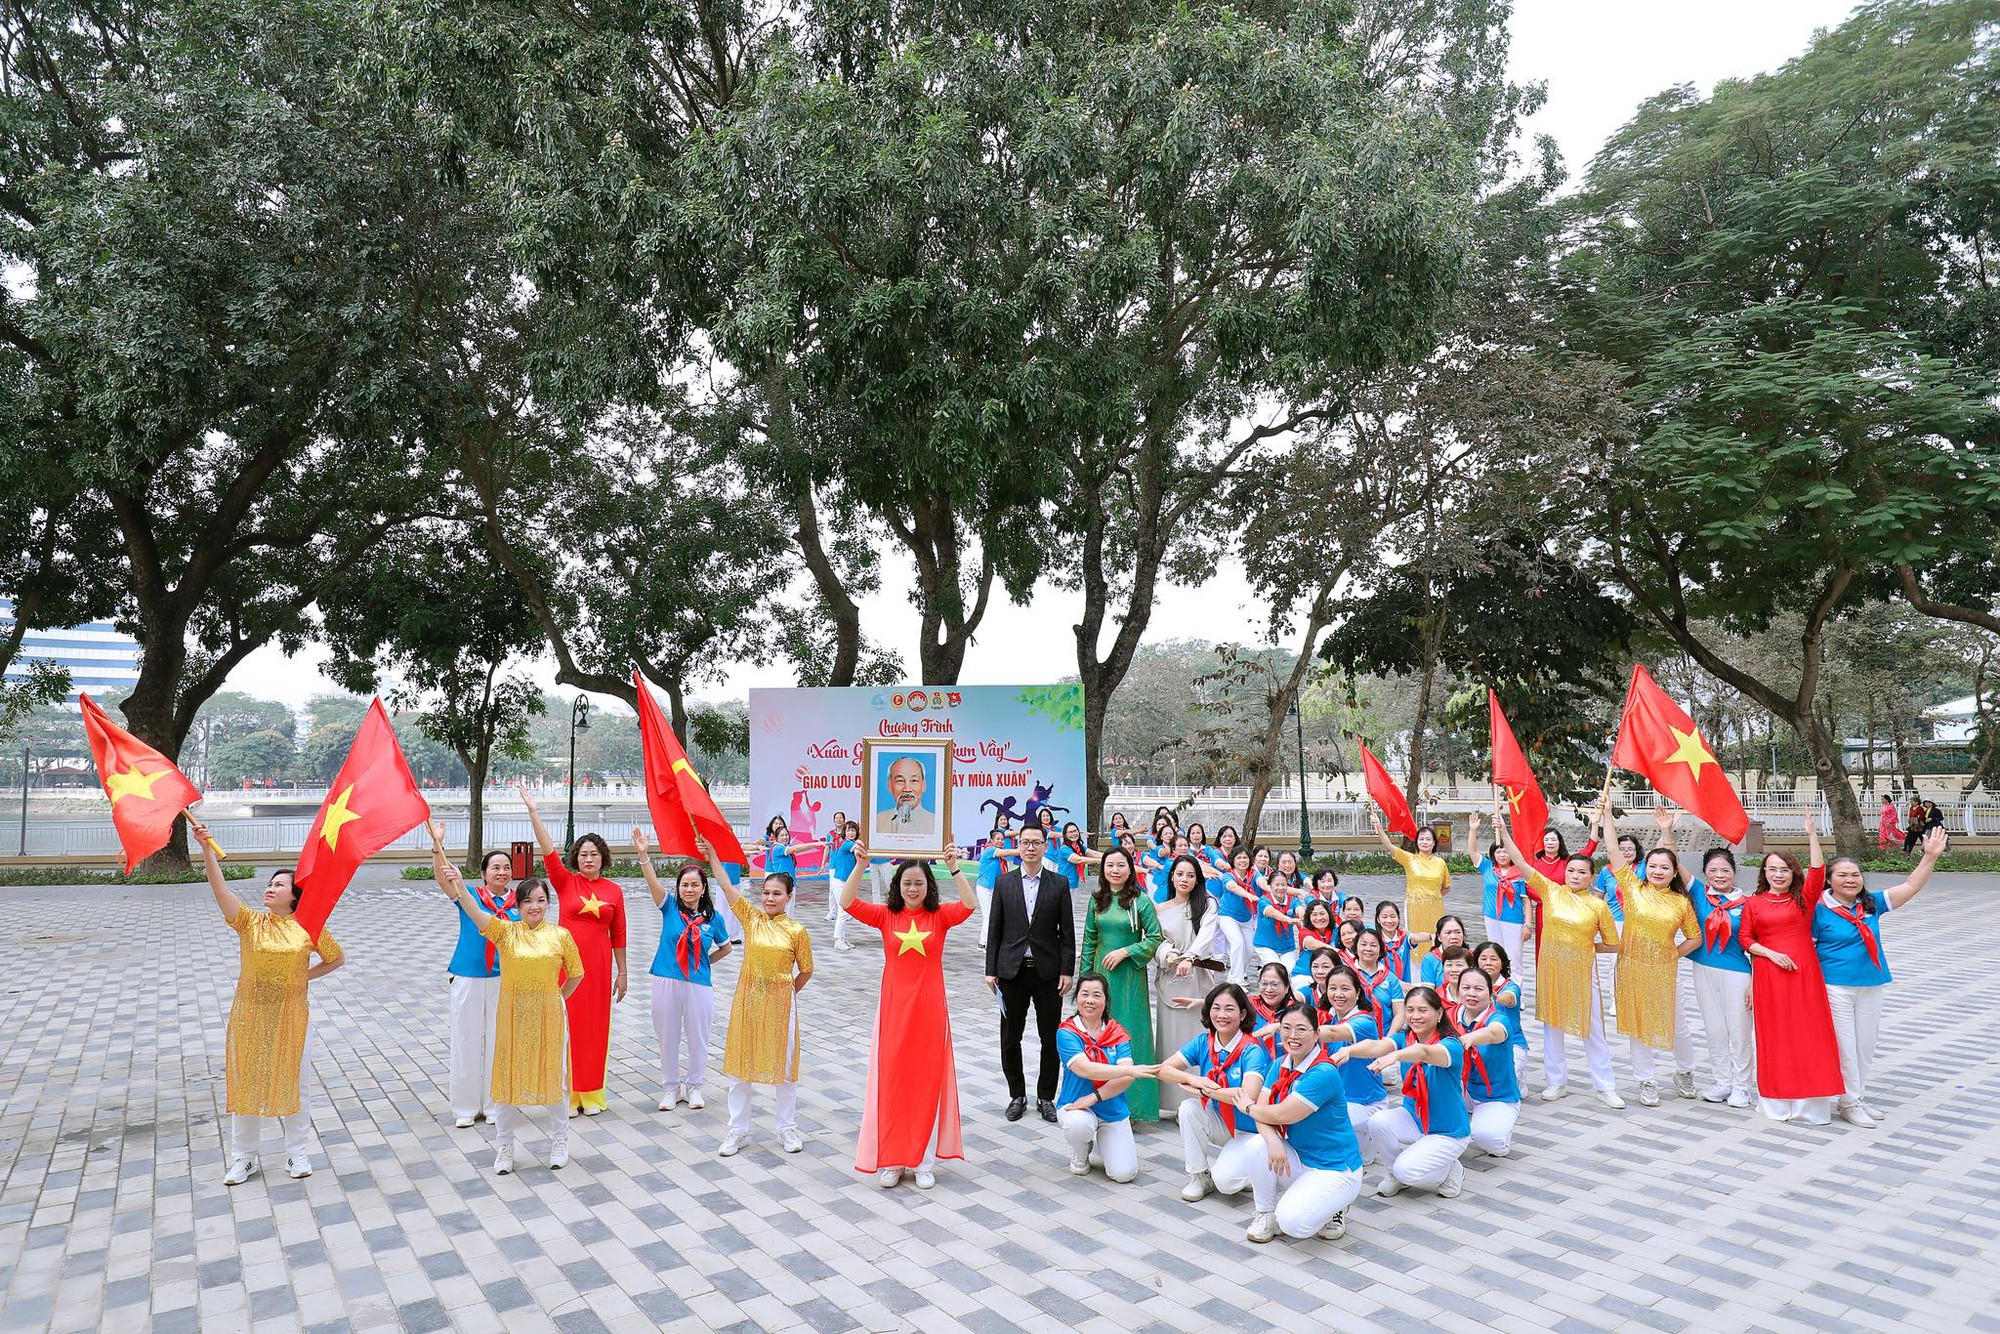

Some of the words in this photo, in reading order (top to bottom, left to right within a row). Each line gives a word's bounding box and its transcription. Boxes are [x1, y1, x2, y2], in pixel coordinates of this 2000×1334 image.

[921, 718, 954, 733] Trình
[831, 774, 852, 789] LƯU
[952, 769, 965, 787] ẢY
[968, 771, 993, 787] MÙA
